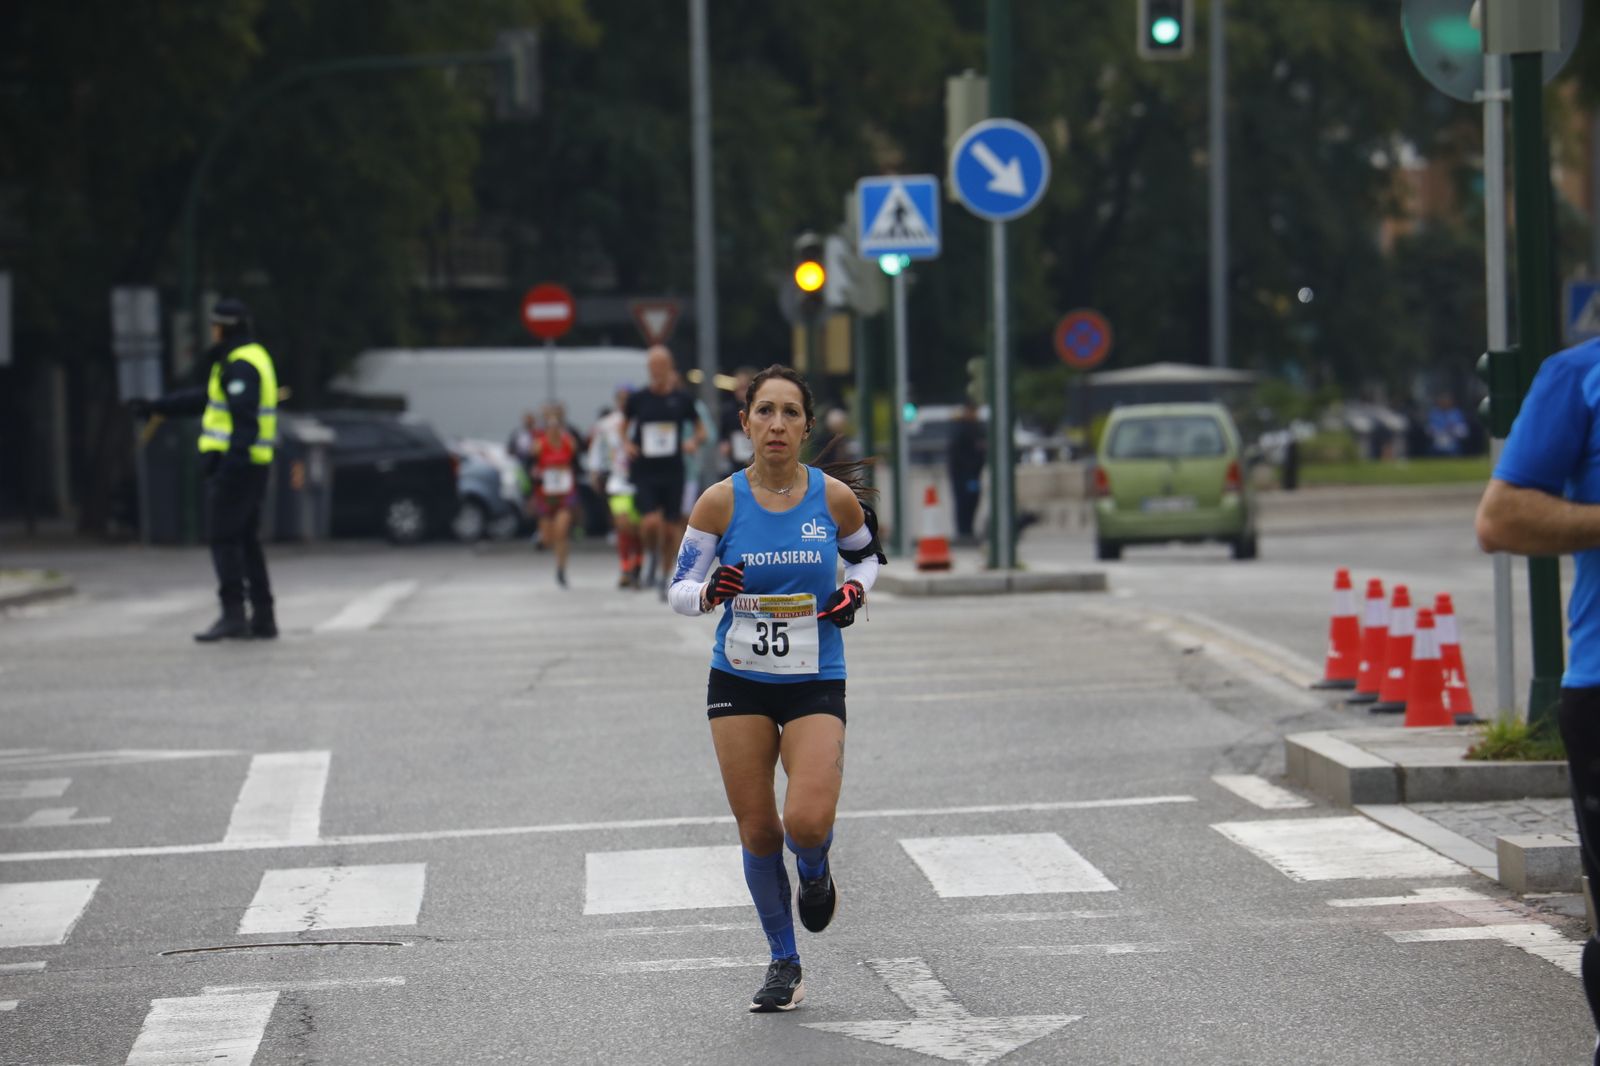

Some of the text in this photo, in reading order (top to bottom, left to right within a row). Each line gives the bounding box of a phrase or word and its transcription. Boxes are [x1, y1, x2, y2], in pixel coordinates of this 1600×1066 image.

[741, 550, 822, 566] TROTASIERRA
[734, 598, 759, 611] XXXIX
[752, 622, 789, 657] 35
